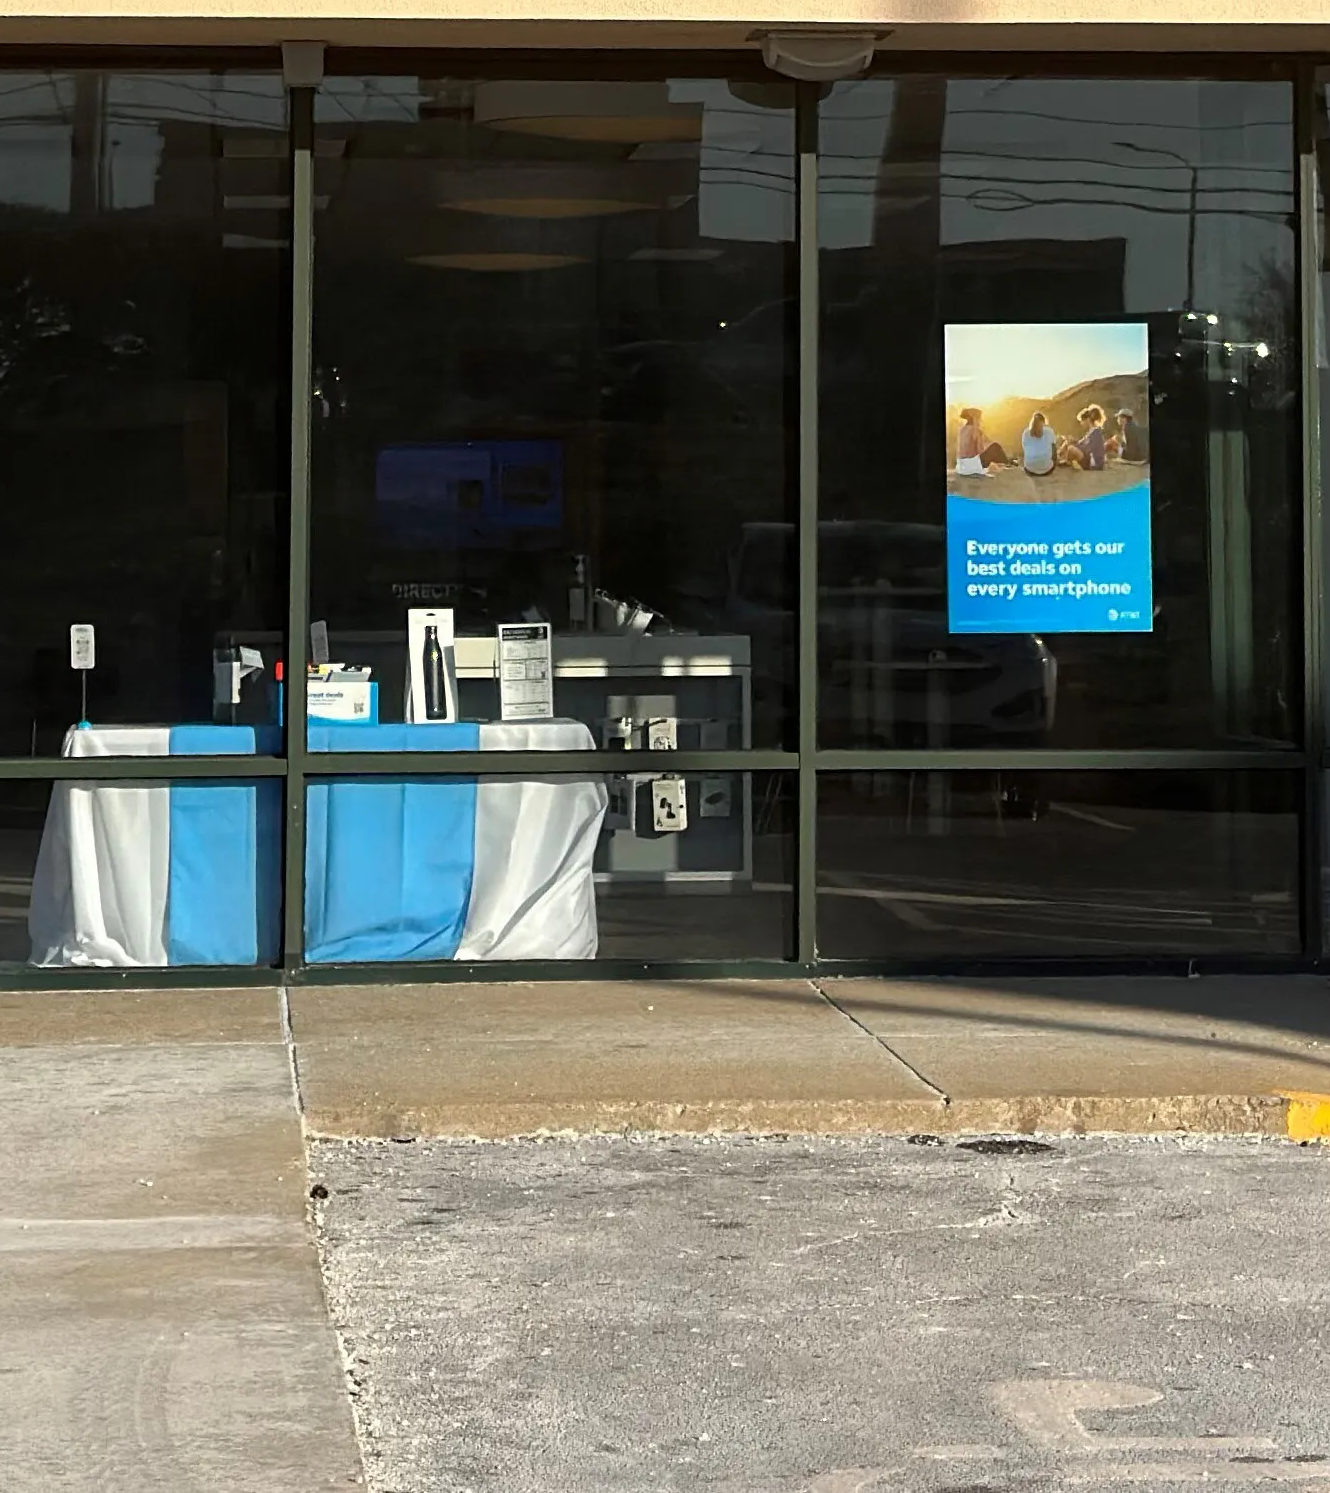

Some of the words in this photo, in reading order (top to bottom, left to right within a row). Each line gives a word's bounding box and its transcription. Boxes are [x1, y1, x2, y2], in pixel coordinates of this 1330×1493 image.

[967, 540, 1049, 559] Everyone
[1052, 540, 1091, 558] gets
[1095, 541, 1125, 554] our
[967, 560, 1005, 575] best
[1010, 560, 1055, 575] deals
[1059, 562, 1081, 575] on
[967, 582, 1017, 600] every
[1022, 579, 1131, 599] smartphone
